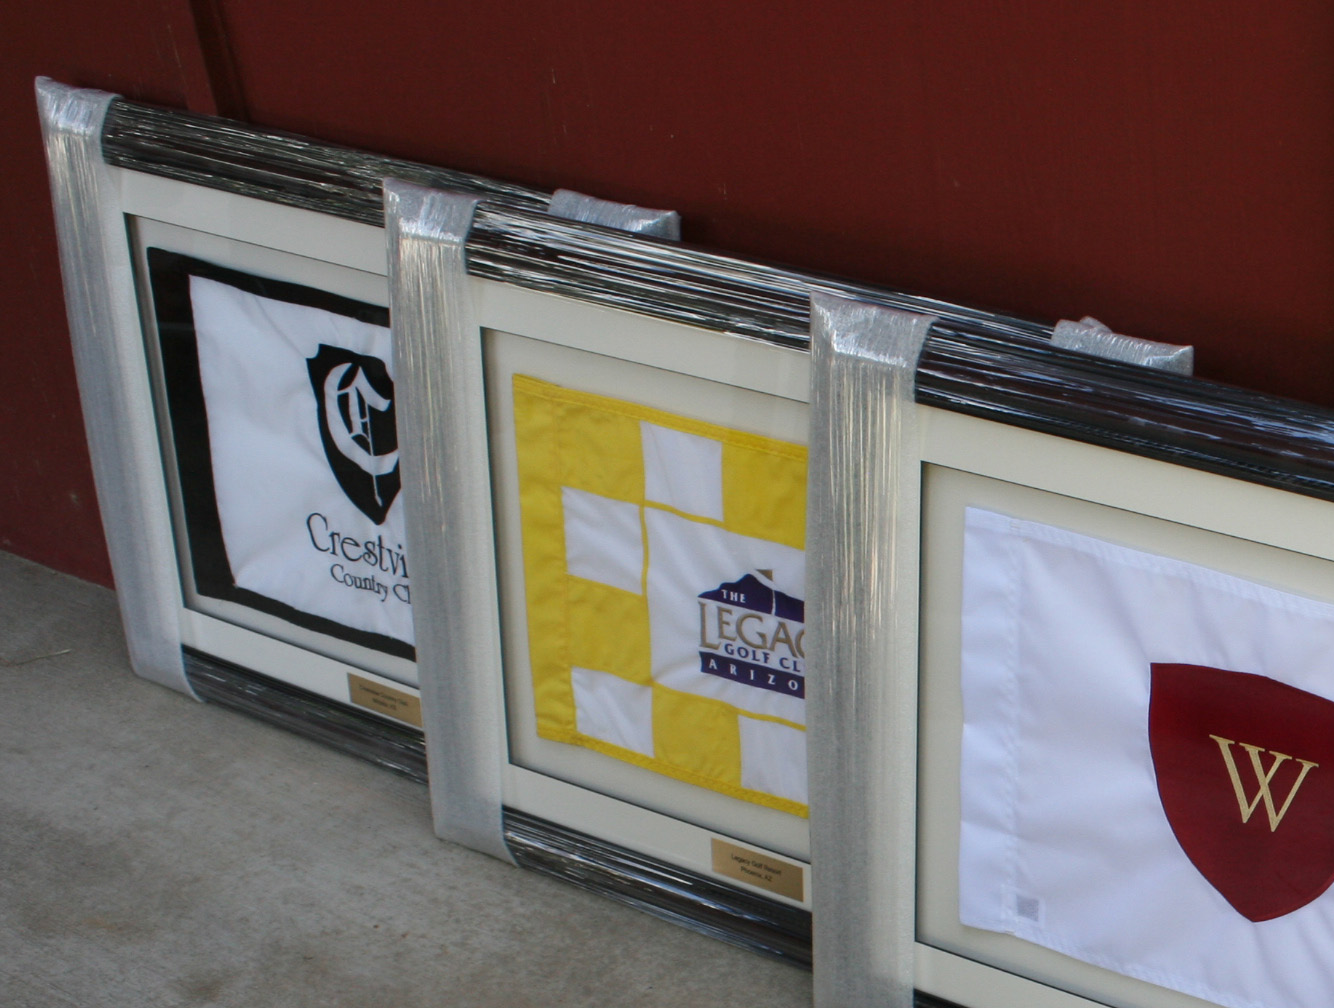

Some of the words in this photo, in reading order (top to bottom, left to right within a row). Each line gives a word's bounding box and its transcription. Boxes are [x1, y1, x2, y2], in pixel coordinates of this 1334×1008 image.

[330, 563, 389, 603] Country
[721, 589, 746, 604] THE
[724, 642, 771, 664] GOLF
[1208, 734, 1319, 832] W
